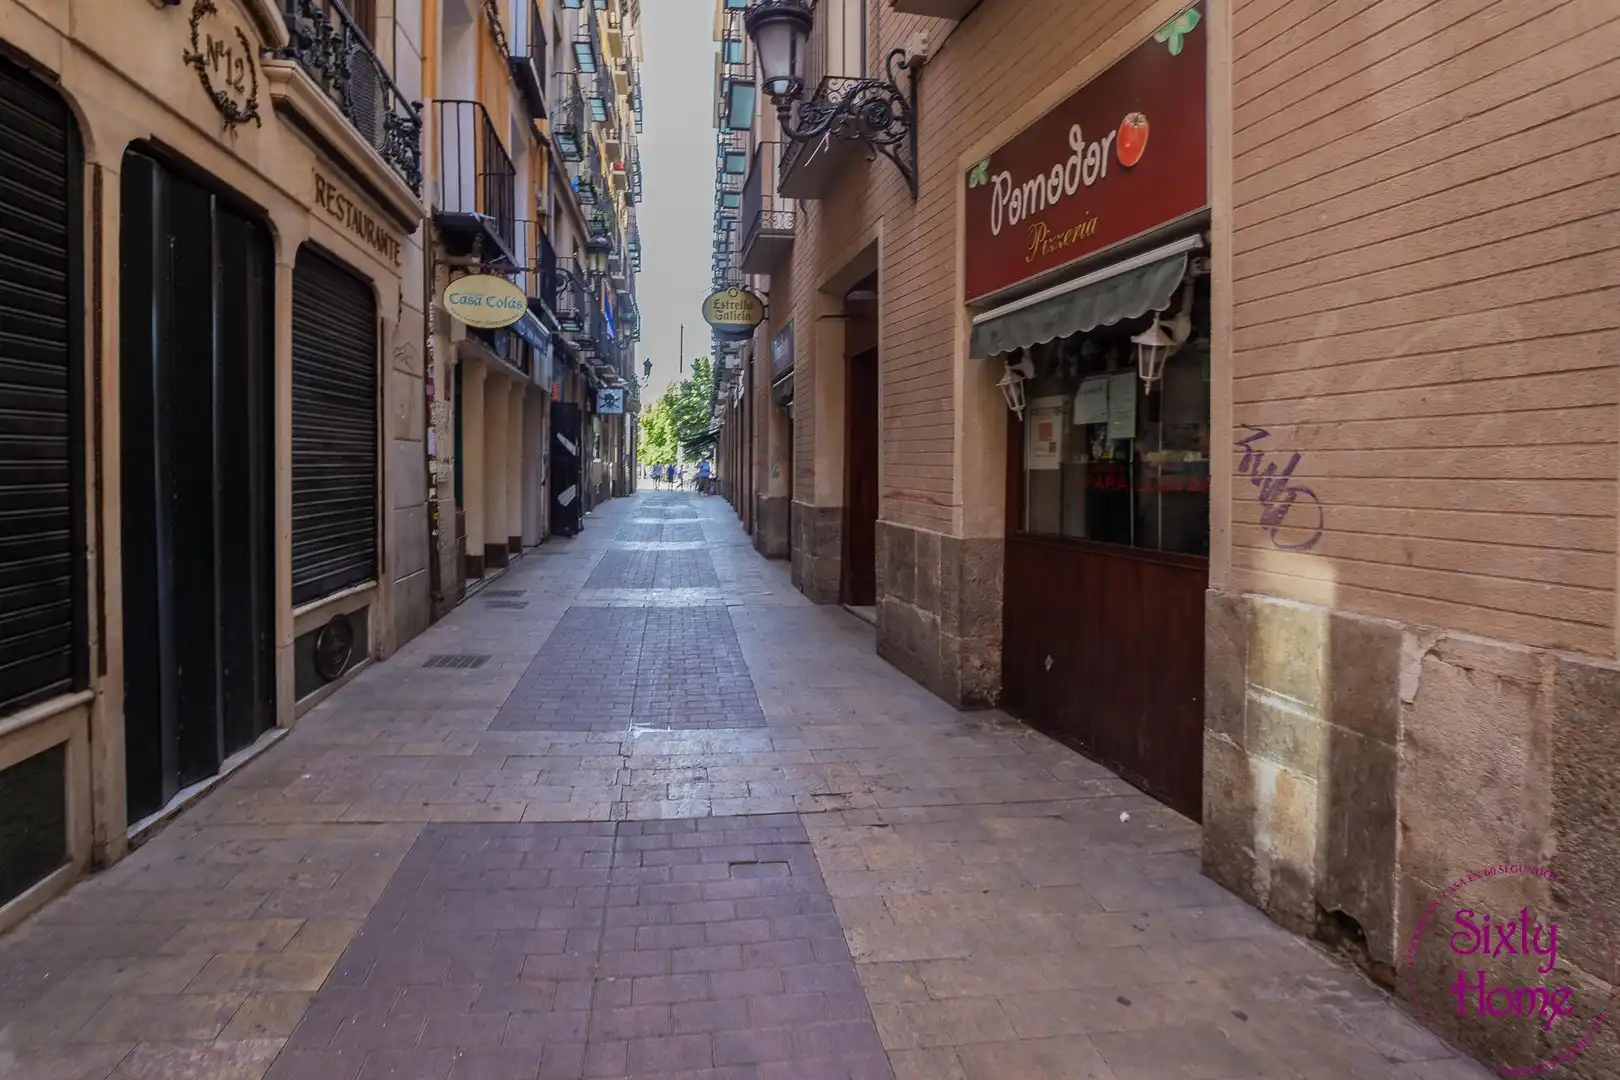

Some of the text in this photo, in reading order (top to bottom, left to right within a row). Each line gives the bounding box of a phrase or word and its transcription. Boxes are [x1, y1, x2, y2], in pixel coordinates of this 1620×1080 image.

[314, 172, 402, 268] RESTAURANTE
[1025, 210, 1099, 263] Pizzeria
[449, 291, 522, 310] Casa Colás
[713, 298, 753, 310] Estrella
[715, 309, 751, 321] Galicia
